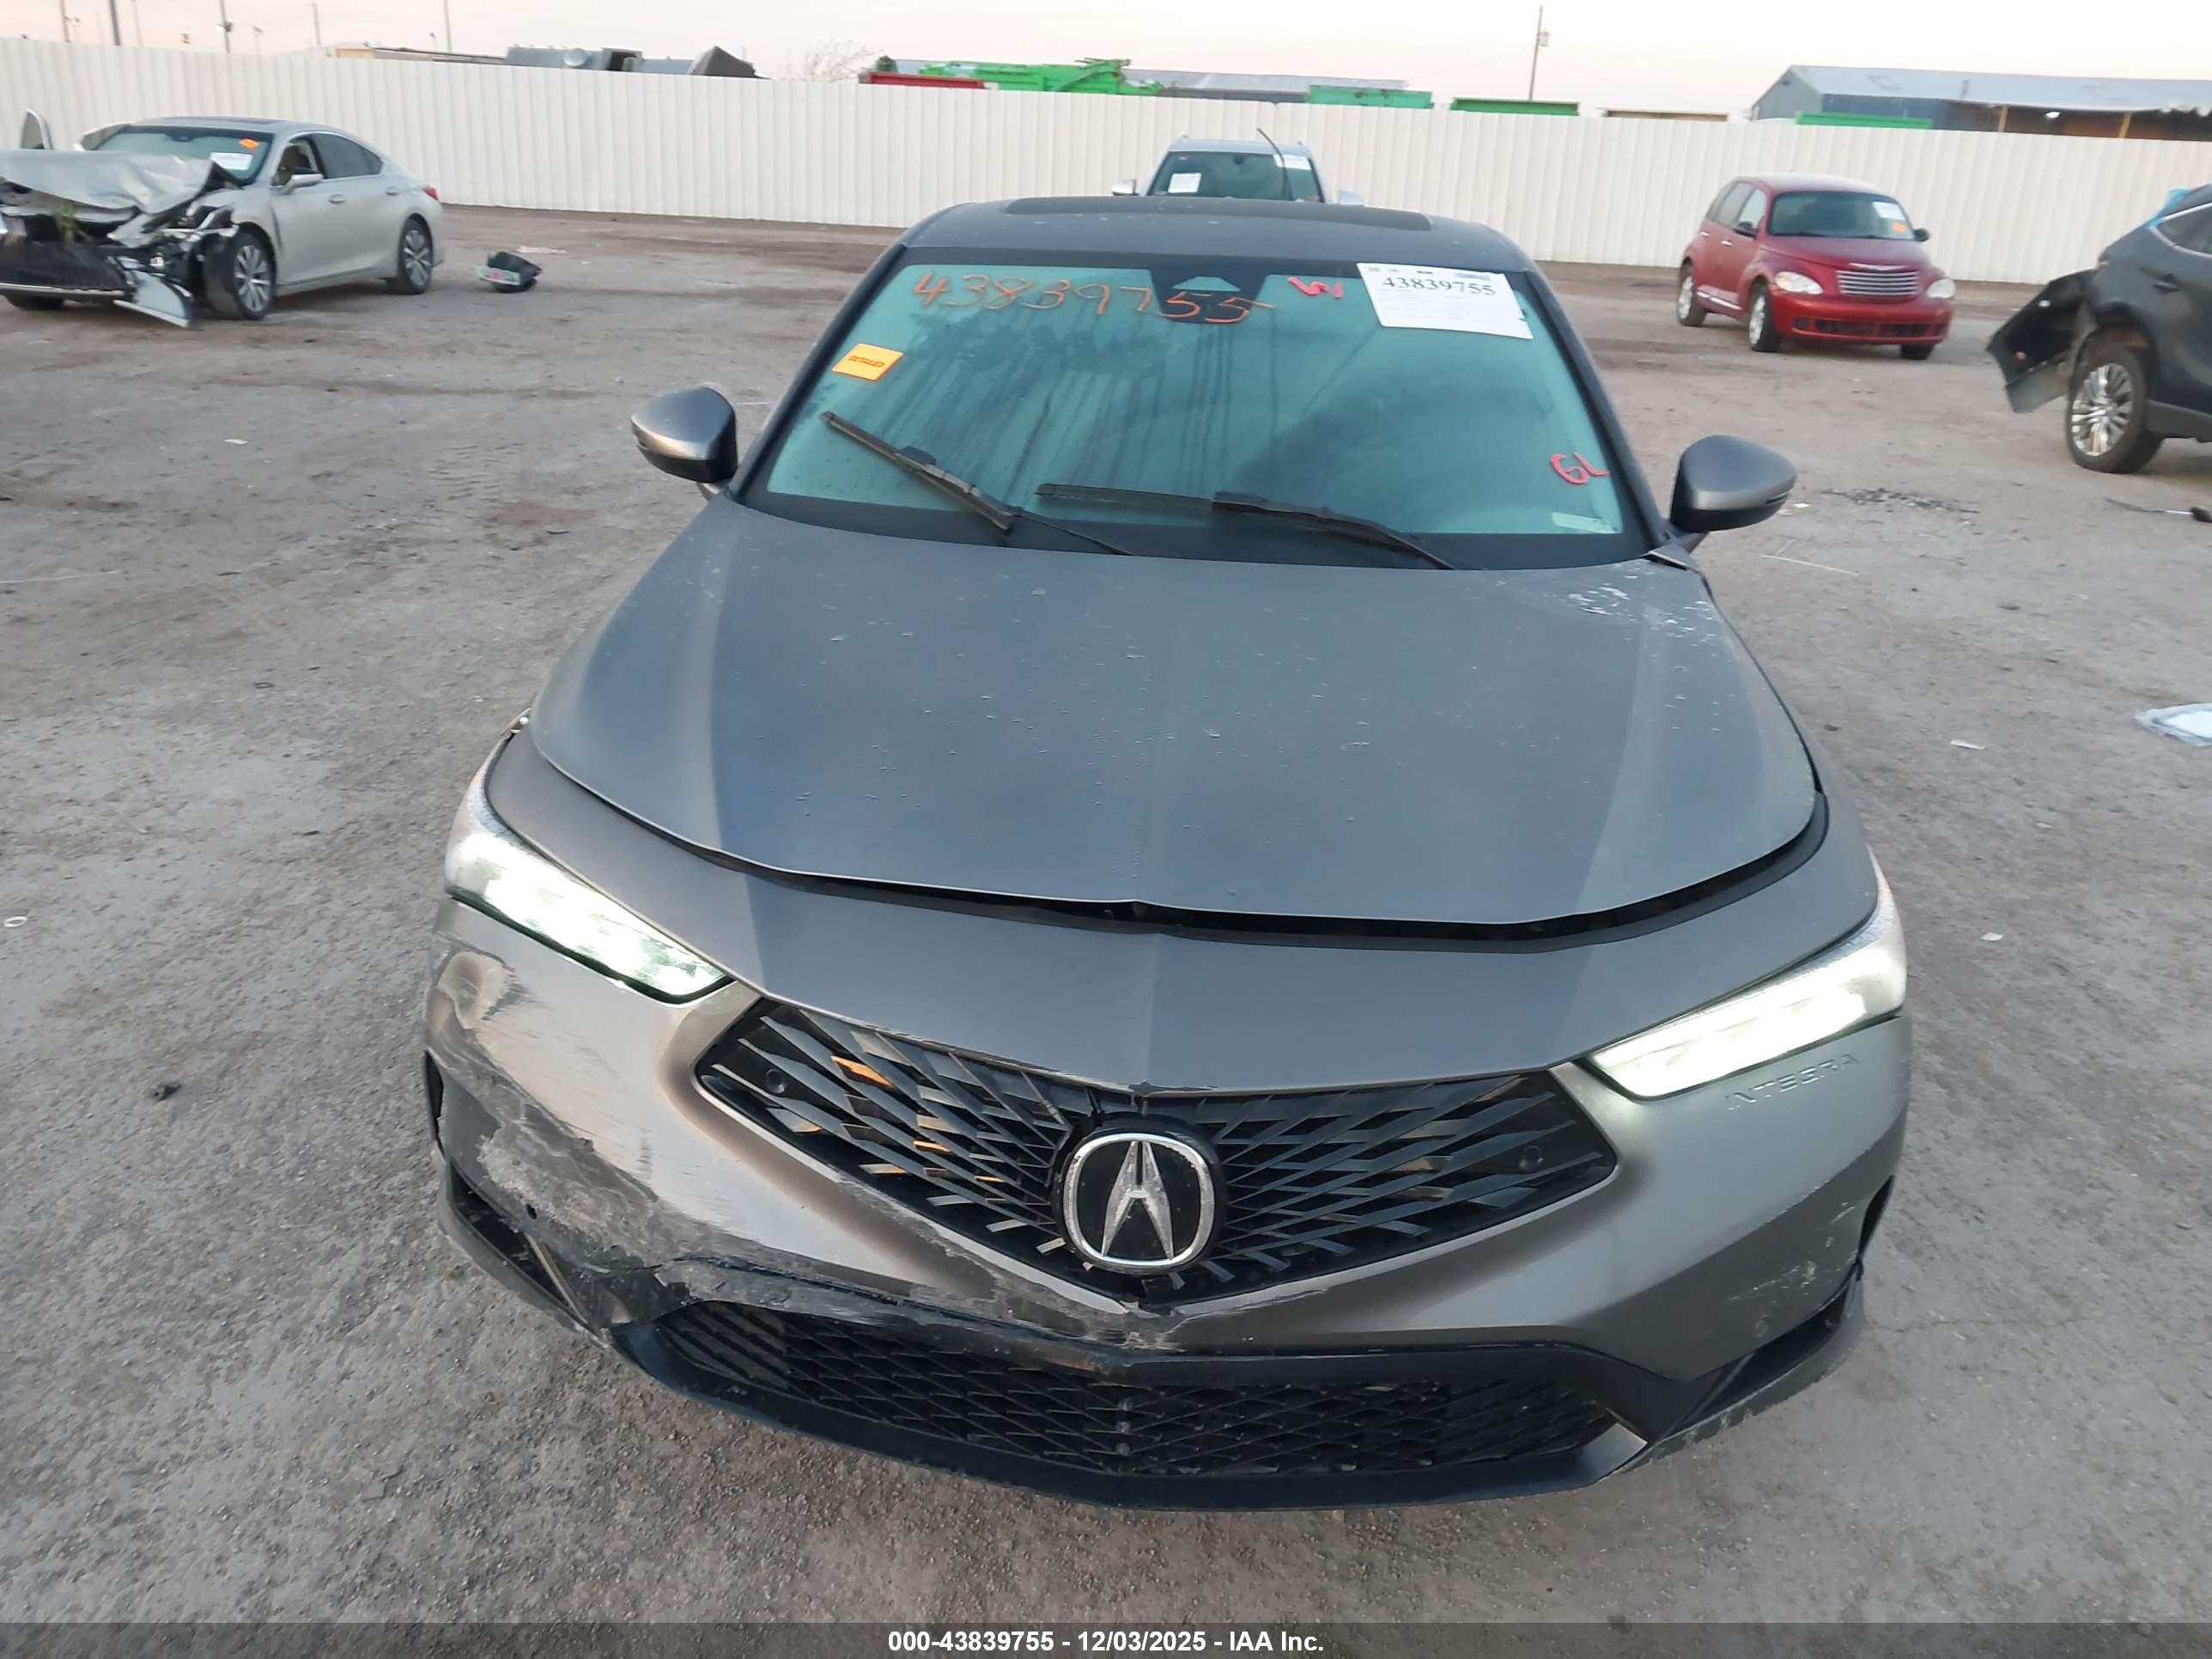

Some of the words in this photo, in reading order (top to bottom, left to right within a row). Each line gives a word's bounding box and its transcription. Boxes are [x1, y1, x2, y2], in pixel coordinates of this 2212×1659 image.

[914, 271, 1275, 324] 43839755
[1382, 276, 1497, 296] 43839755
[1724, 1053, 1861, 1110] INTEGRA
